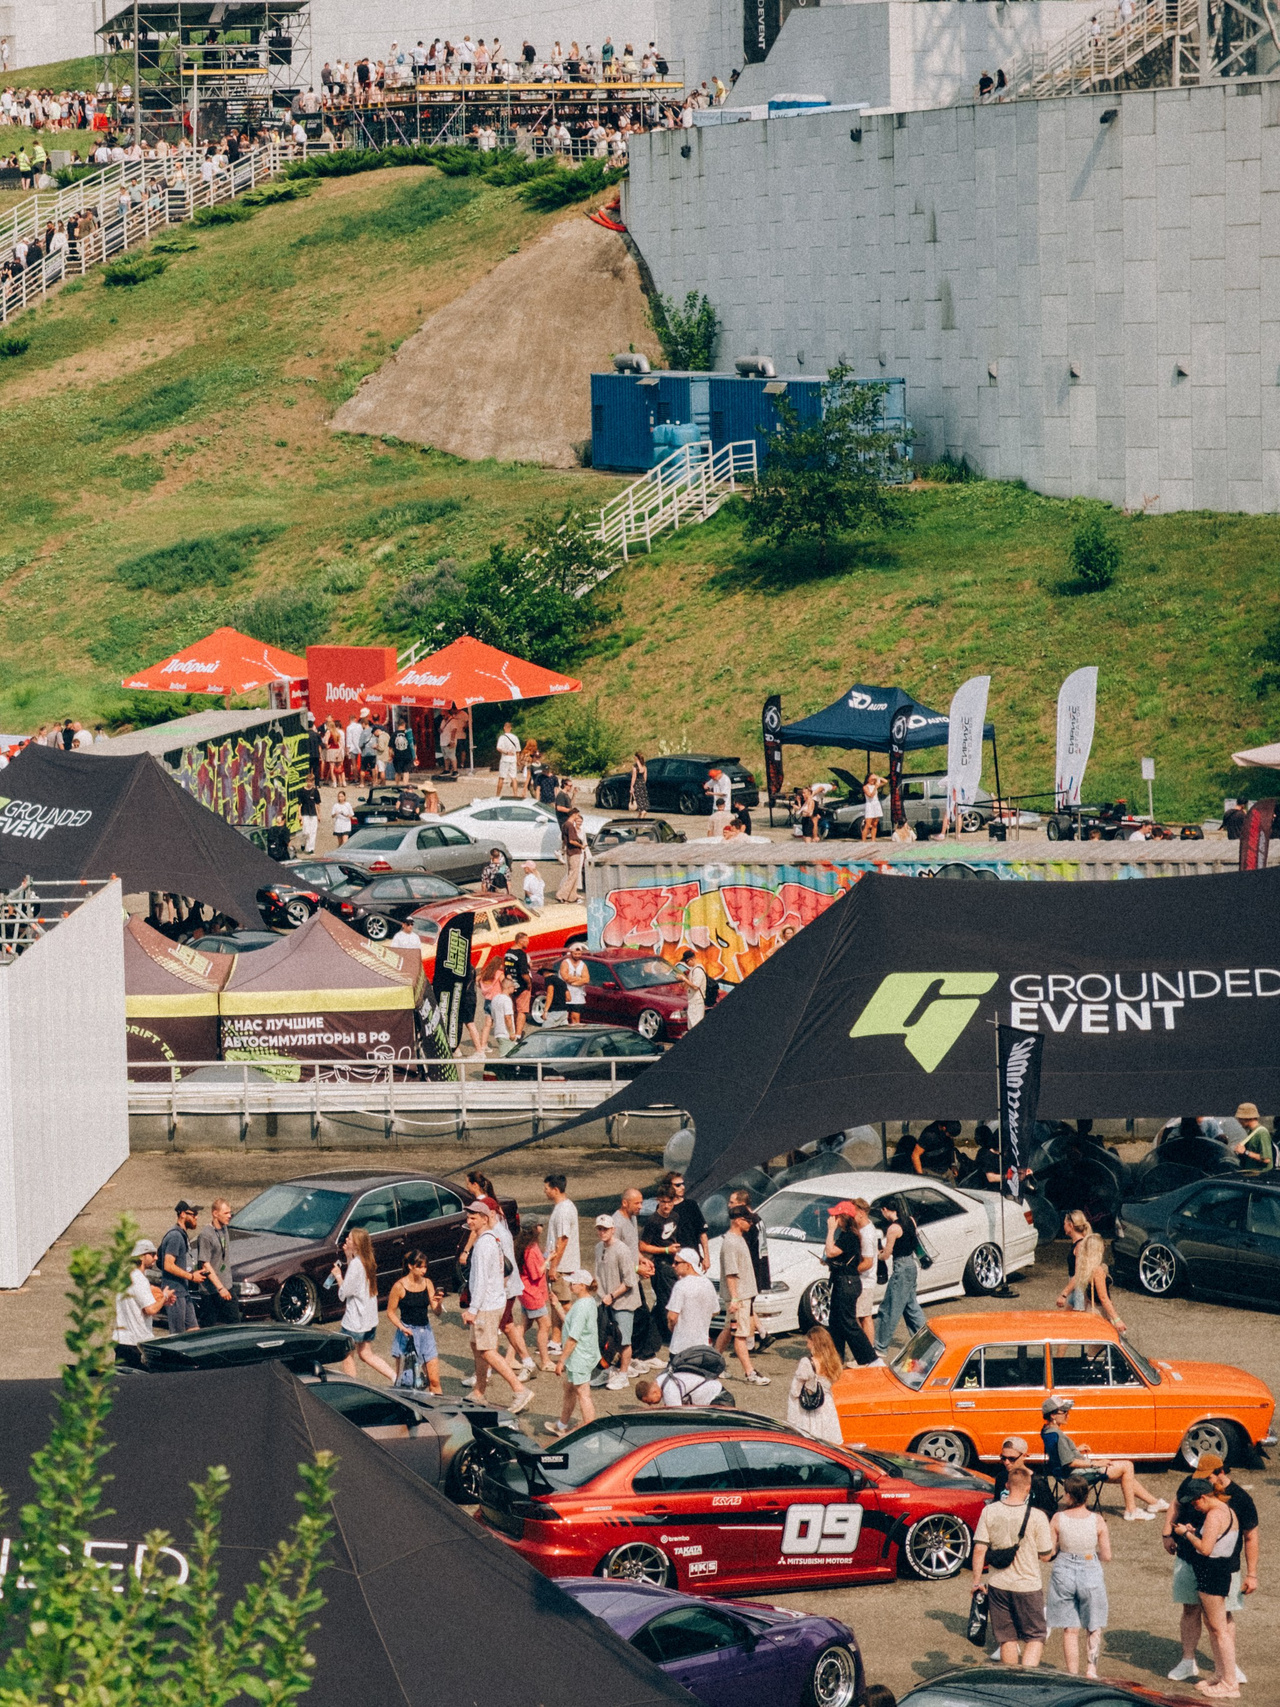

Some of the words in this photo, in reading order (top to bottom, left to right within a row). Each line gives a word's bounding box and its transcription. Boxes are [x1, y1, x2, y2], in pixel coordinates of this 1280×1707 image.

[160, 658, 220, 674] Добрый
[395, 670, 452, 687] Добрый
[867, 703, 888, 711] AUTO
[4, 800, 93, 827] GROUNDED
[1009, 969, 1280, 1002] GROUNDED
[234, 1019, 263, 1032] НАС
[265, 1017, 324, 1031] ЛУЧШИЕ
[1011, 1001, 1185, 1033] EVENT
[223, 1032, 355, 1048] АВТОСИМУЛЯТОРЫ
[358, 1033, 367, 1044] В
[370, 1031, 391, 1044] РФ
[160, 1042, 182, 1081] TEM
[712, 1496, 742, 1506] KYB
[780, 1503, 864, 1555] 09
[674, 1545, 703, 1556] TAKATA
[689, 1561, 718, 1574] HKS
